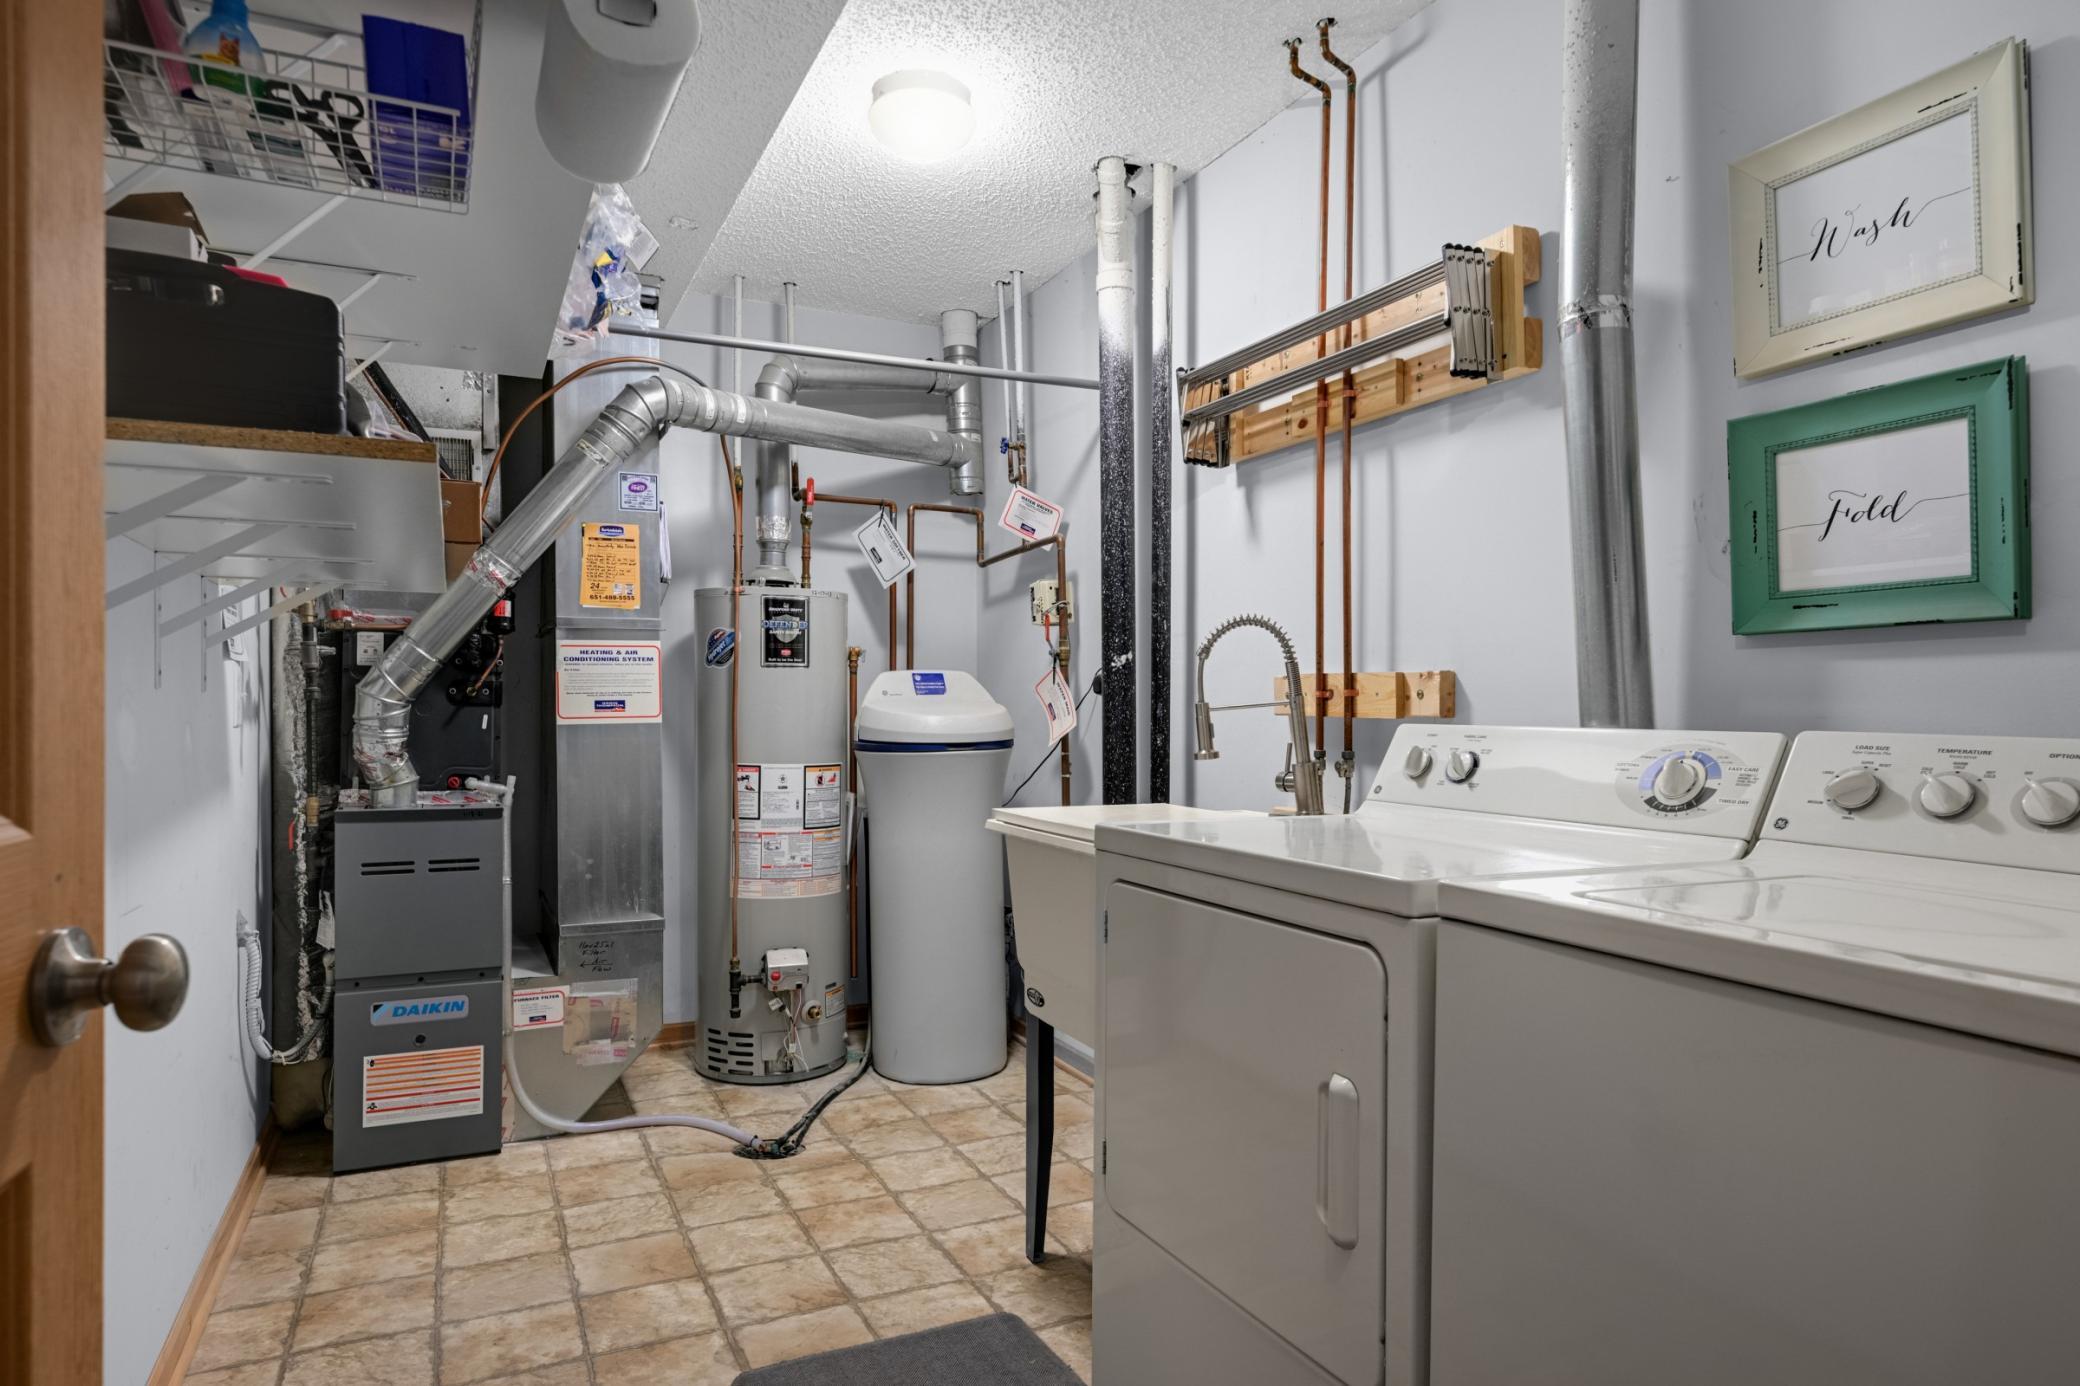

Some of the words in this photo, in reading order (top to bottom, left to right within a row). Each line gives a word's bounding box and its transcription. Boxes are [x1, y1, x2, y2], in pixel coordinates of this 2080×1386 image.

[1808, 196, 1916, 262] Wash
[1817, 489, 1912, 542] Fold
[590, 582, 600, 590] 24
[1937, 748, 1992, 756] TEMPERATURE
[391, 1000, 465, 1018] DAIKIN
